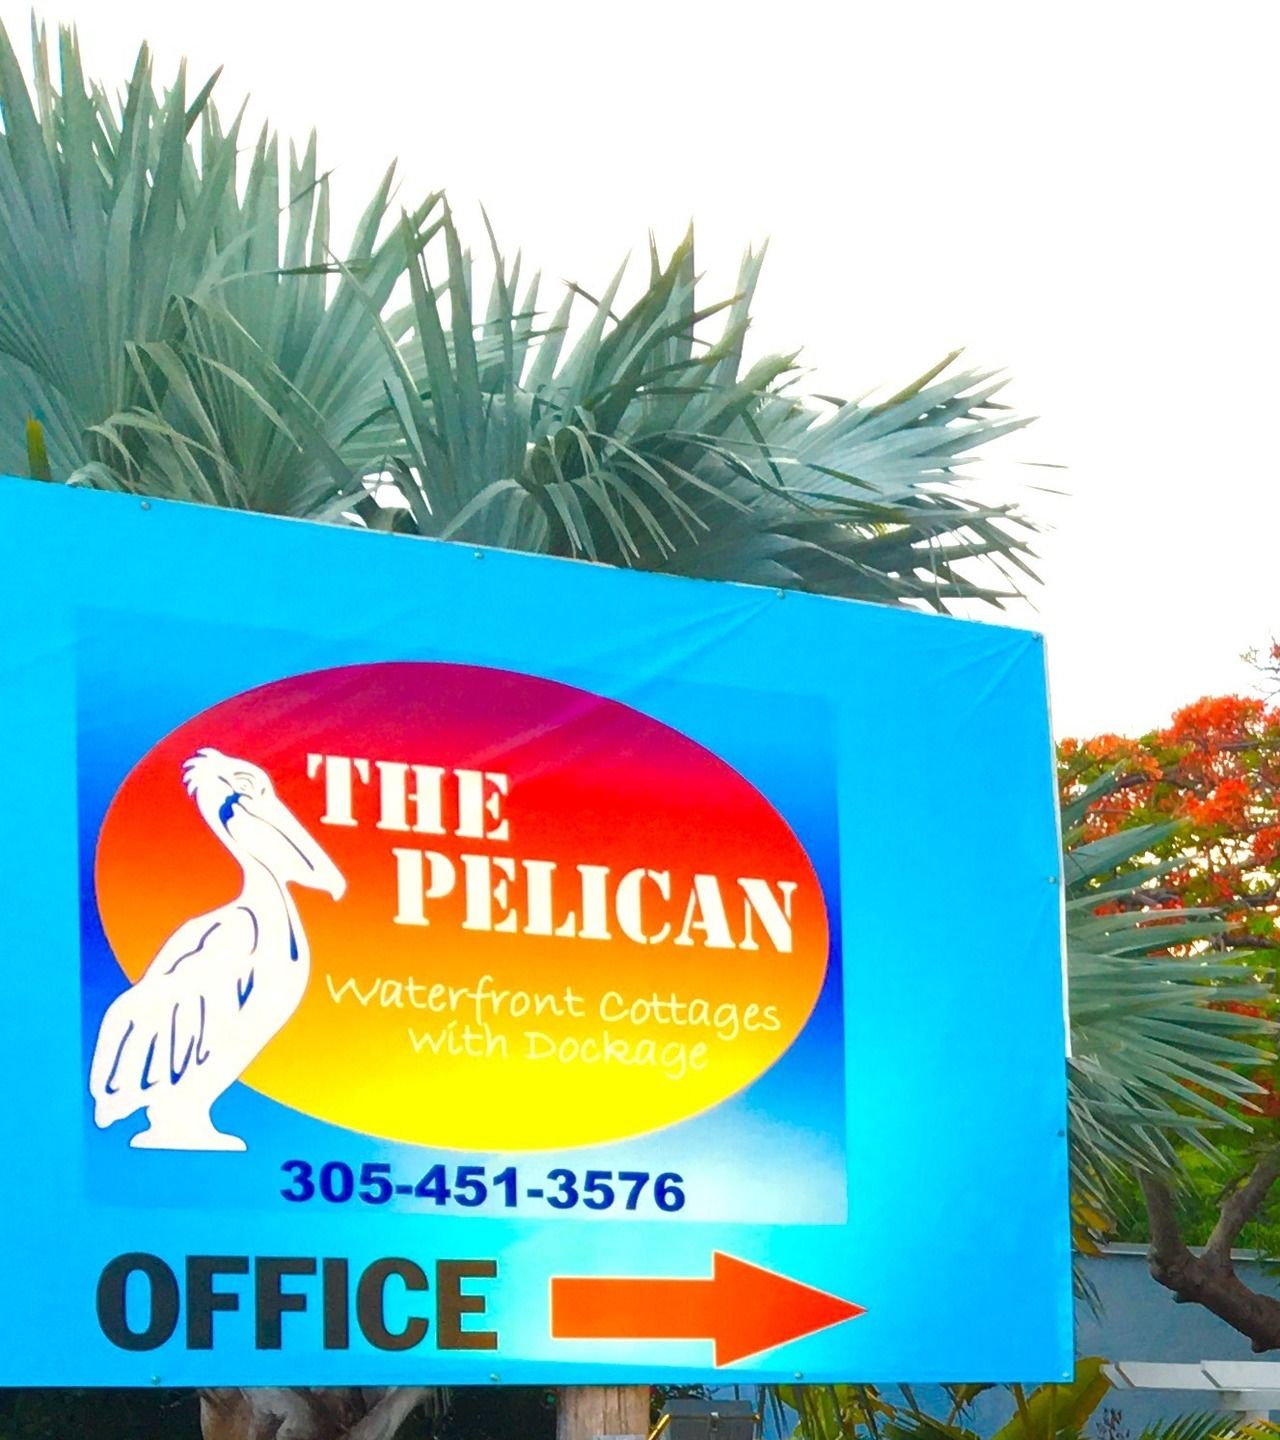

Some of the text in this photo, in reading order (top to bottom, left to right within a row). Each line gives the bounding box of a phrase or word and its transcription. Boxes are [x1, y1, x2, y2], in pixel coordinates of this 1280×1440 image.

[306, 752, 510, 841] THE
[391, 847, 798, 953] PELICAN
[326, 974, 781, 1041] Waterfront Cottages
[407, 1020, 709, 1080] with Dockage
[279, 1159, 686, 1212] 305-451-3576
[96, 1251, 498, 1351] OFFICE
